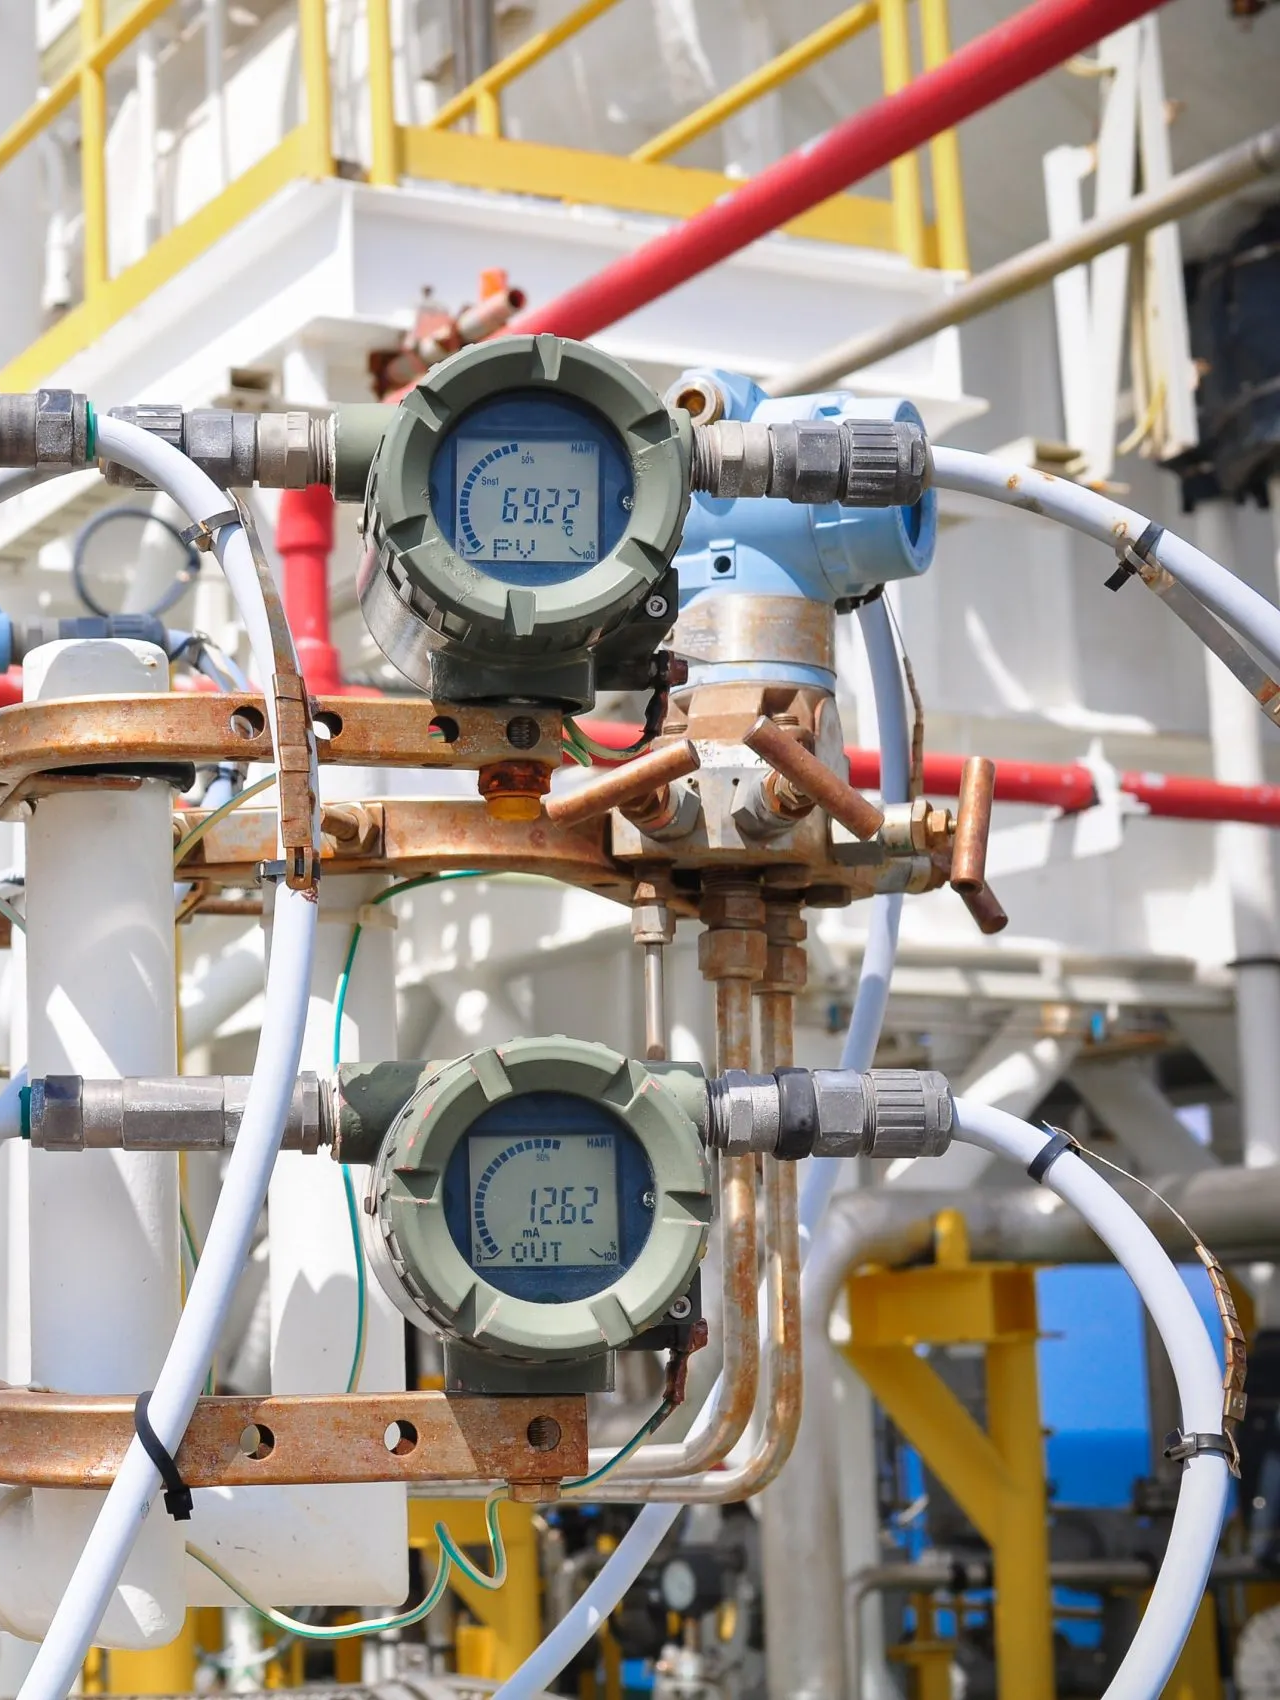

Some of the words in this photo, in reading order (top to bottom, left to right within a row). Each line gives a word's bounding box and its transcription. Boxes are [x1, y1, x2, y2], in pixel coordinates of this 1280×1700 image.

[570, 443, 596, 453] HART
[521, 456, 535, 464] 50%
[481, 476, 499, 486] Sns1
[502, 487, 581, 524] 69.22
[493, 539, 536, 558] PV
[582, 551, 596, 560] 100
[586, 1137, 613, 1148] HART
[529, 1186, 599, 1225] 12.62
[522, 1227, 540, 1238] mA
[511, 1242, 562, 1262] OUT
[603, 1252, 617, 1261] 100
